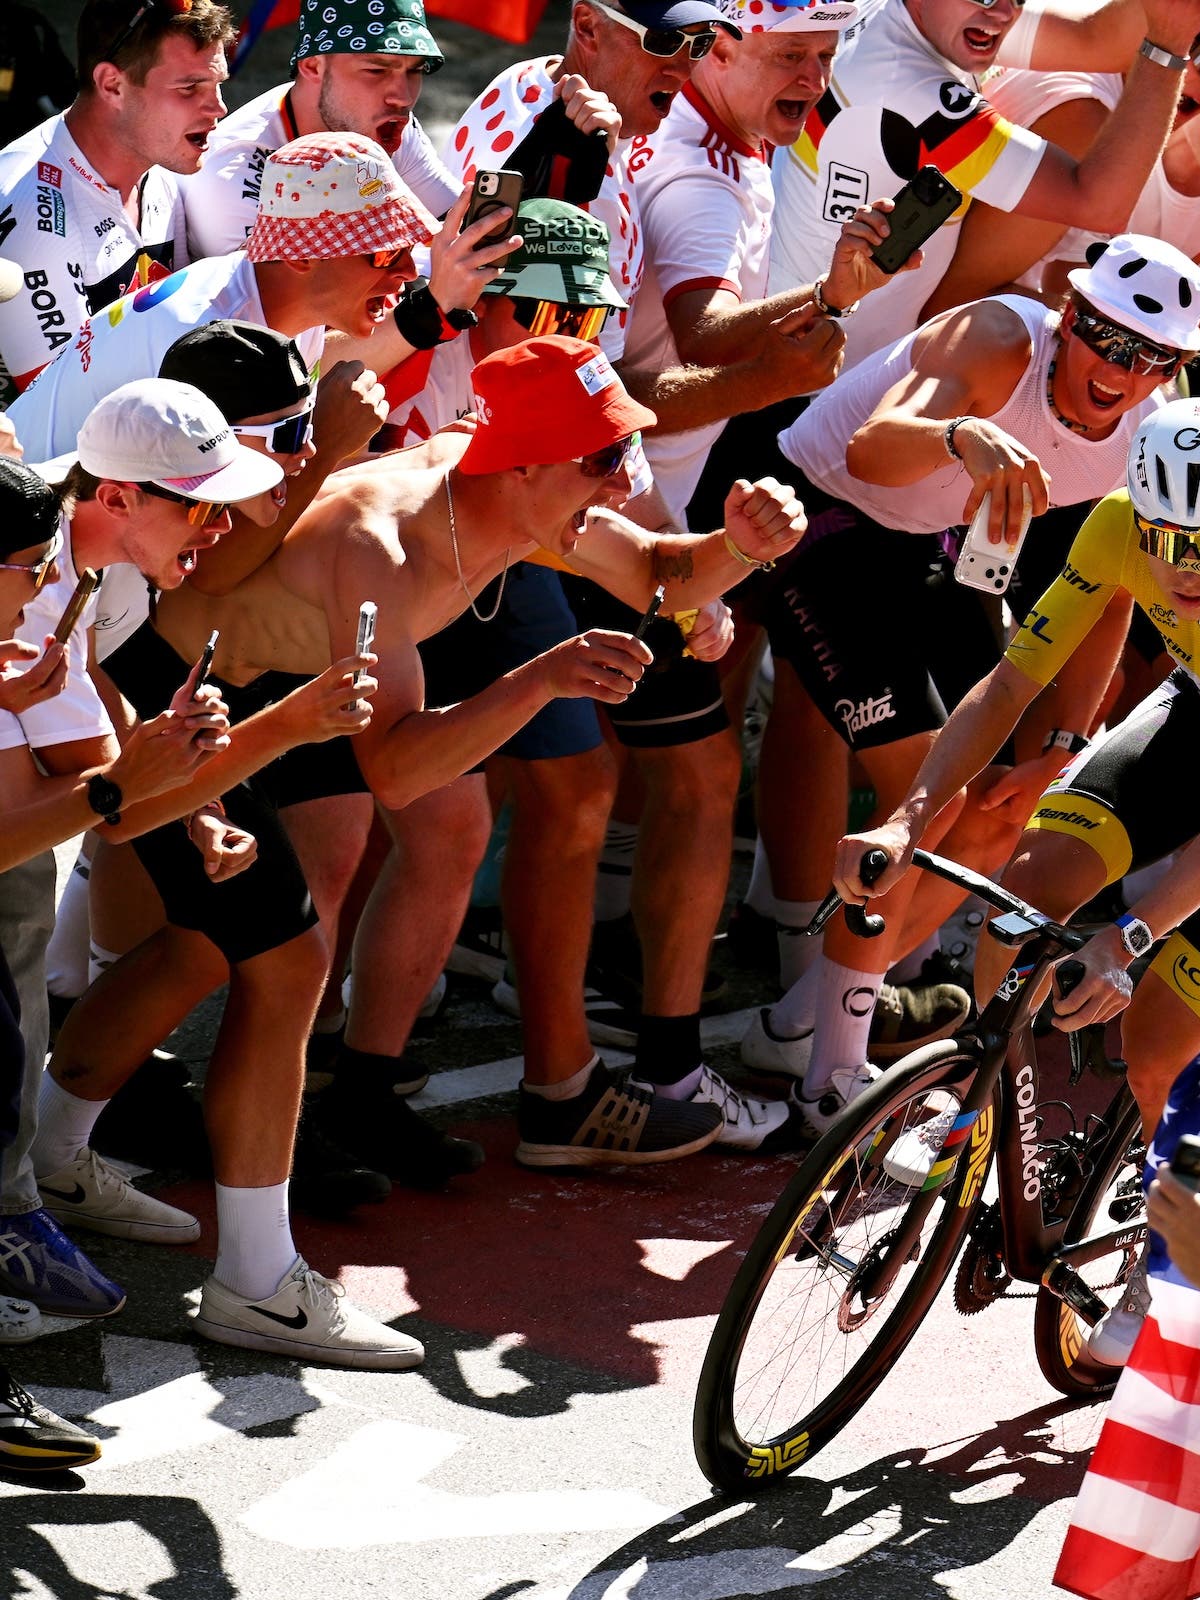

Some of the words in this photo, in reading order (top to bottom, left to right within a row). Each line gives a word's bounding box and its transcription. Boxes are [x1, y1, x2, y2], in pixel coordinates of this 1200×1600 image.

[37, 185, 52, 232] BORA
[830, 172, 862, 221] 311
[94, 217, 116, 237] BOSS
[525, 243, 546, 254] We
[550, 242, 580, 253] Love
[24, 269, 73, 350] BORA
[1136, 436, 1150, 492] MET
[835, 694, 896, 743] Patta
[1014, 1064, 1042, 1202] COLNAGO
